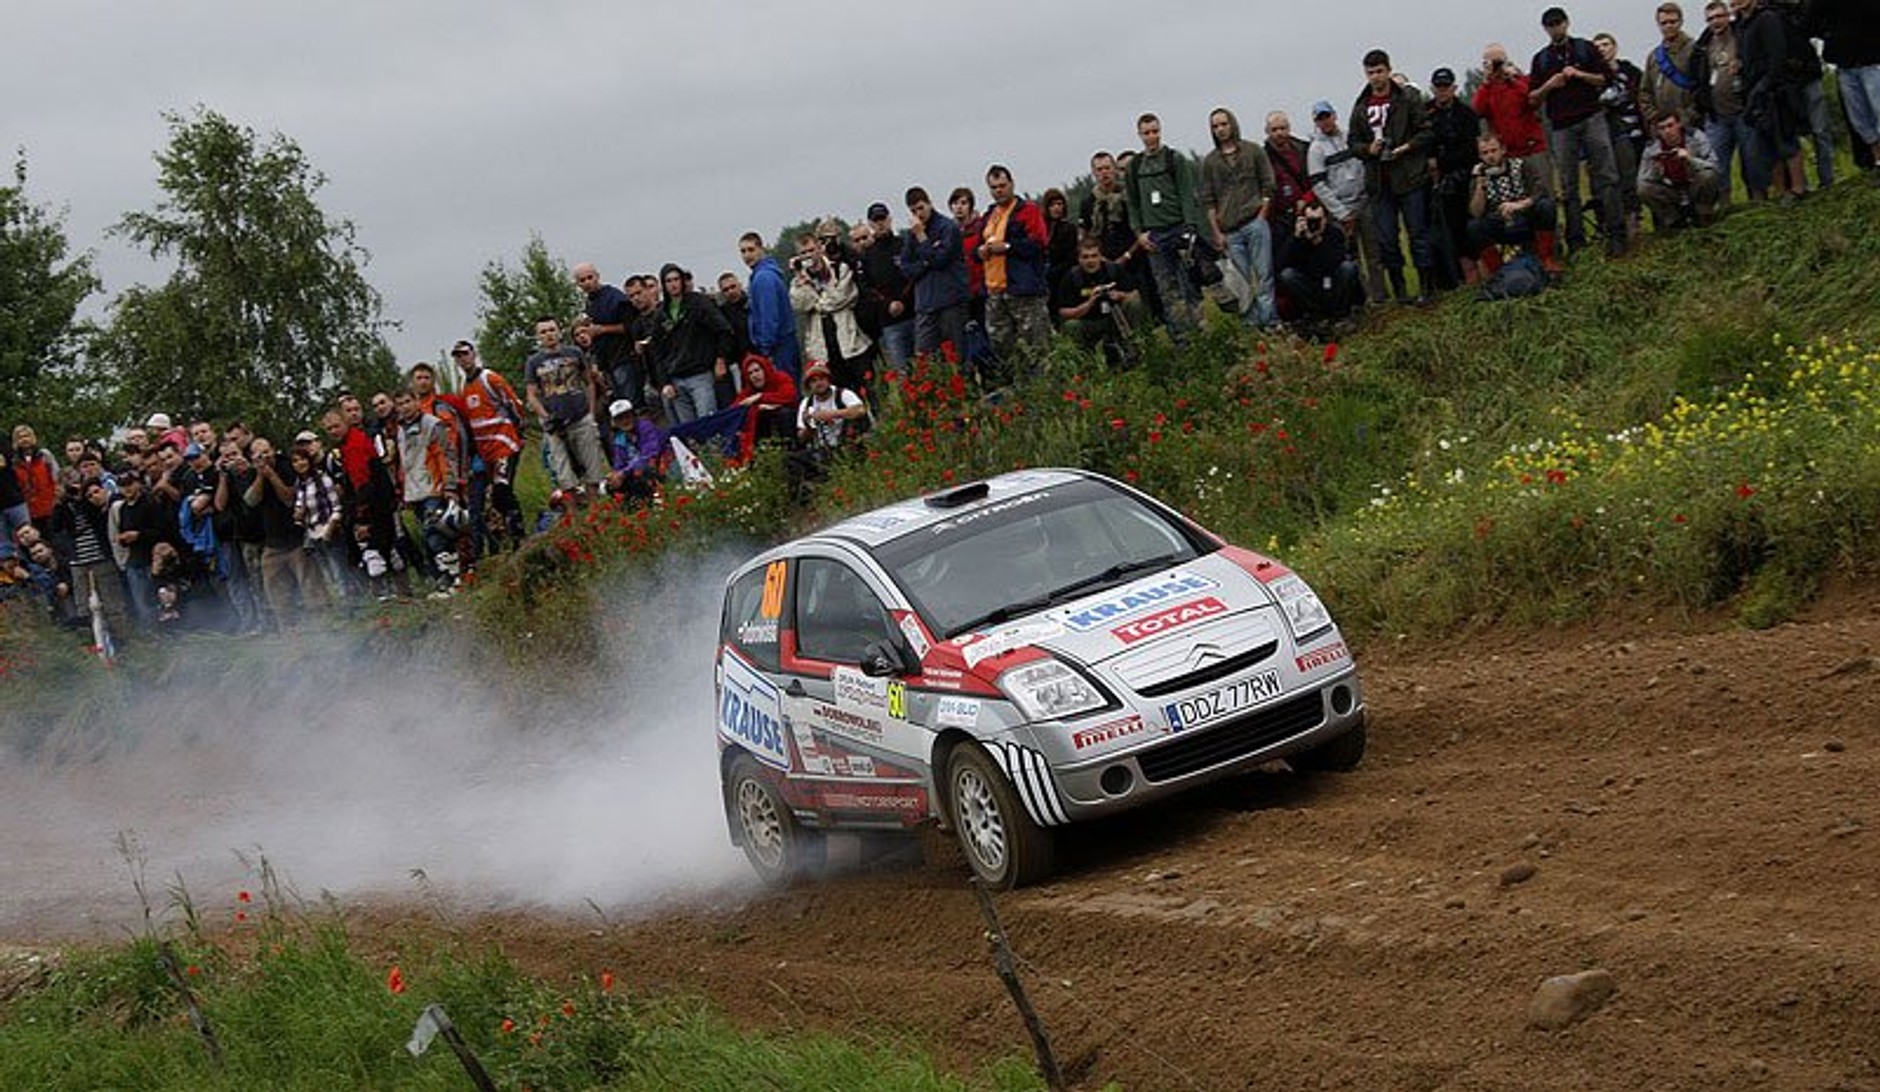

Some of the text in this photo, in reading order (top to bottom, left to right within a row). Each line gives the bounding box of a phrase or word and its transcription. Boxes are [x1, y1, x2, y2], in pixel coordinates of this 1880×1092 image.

[761, 560, 787, 619] 60
[1067, 576, 1209, 627] KRAUSE
[1117, 602, 1223, 638] TOTAL
[1296, 641, 1350, 673] PIRELLI
[721, 685, 785, 757] KRAUSE
[1179, 669, 1283, 726] DDZ 77RW
[1072, 713, 1144, 750] PIRELLI
